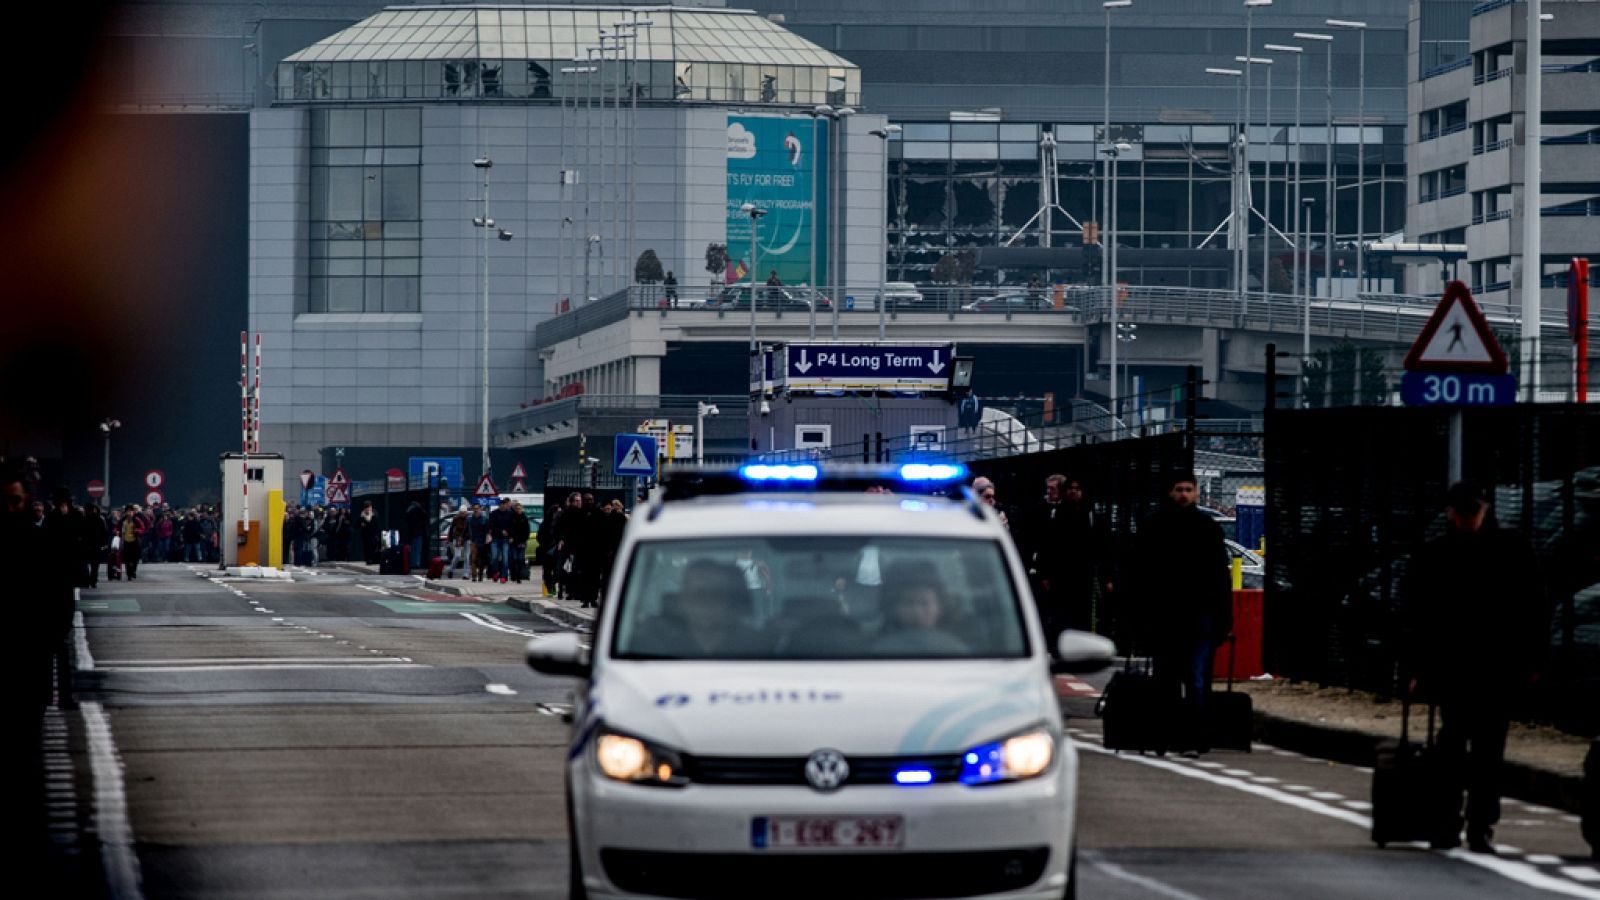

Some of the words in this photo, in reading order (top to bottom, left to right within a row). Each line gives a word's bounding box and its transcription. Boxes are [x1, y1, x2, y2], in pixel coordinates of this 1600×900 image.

[740, 173, 753, 185] FLY
[755, 174, 771, 187] FOR
[816, 353, 837, 367] P4
[841, 352, 881, 370] Long
[884, 352, 923, 367] Term
[1423, 375, 1461, 403] 30
[1467, 383, 1495, 403] m
